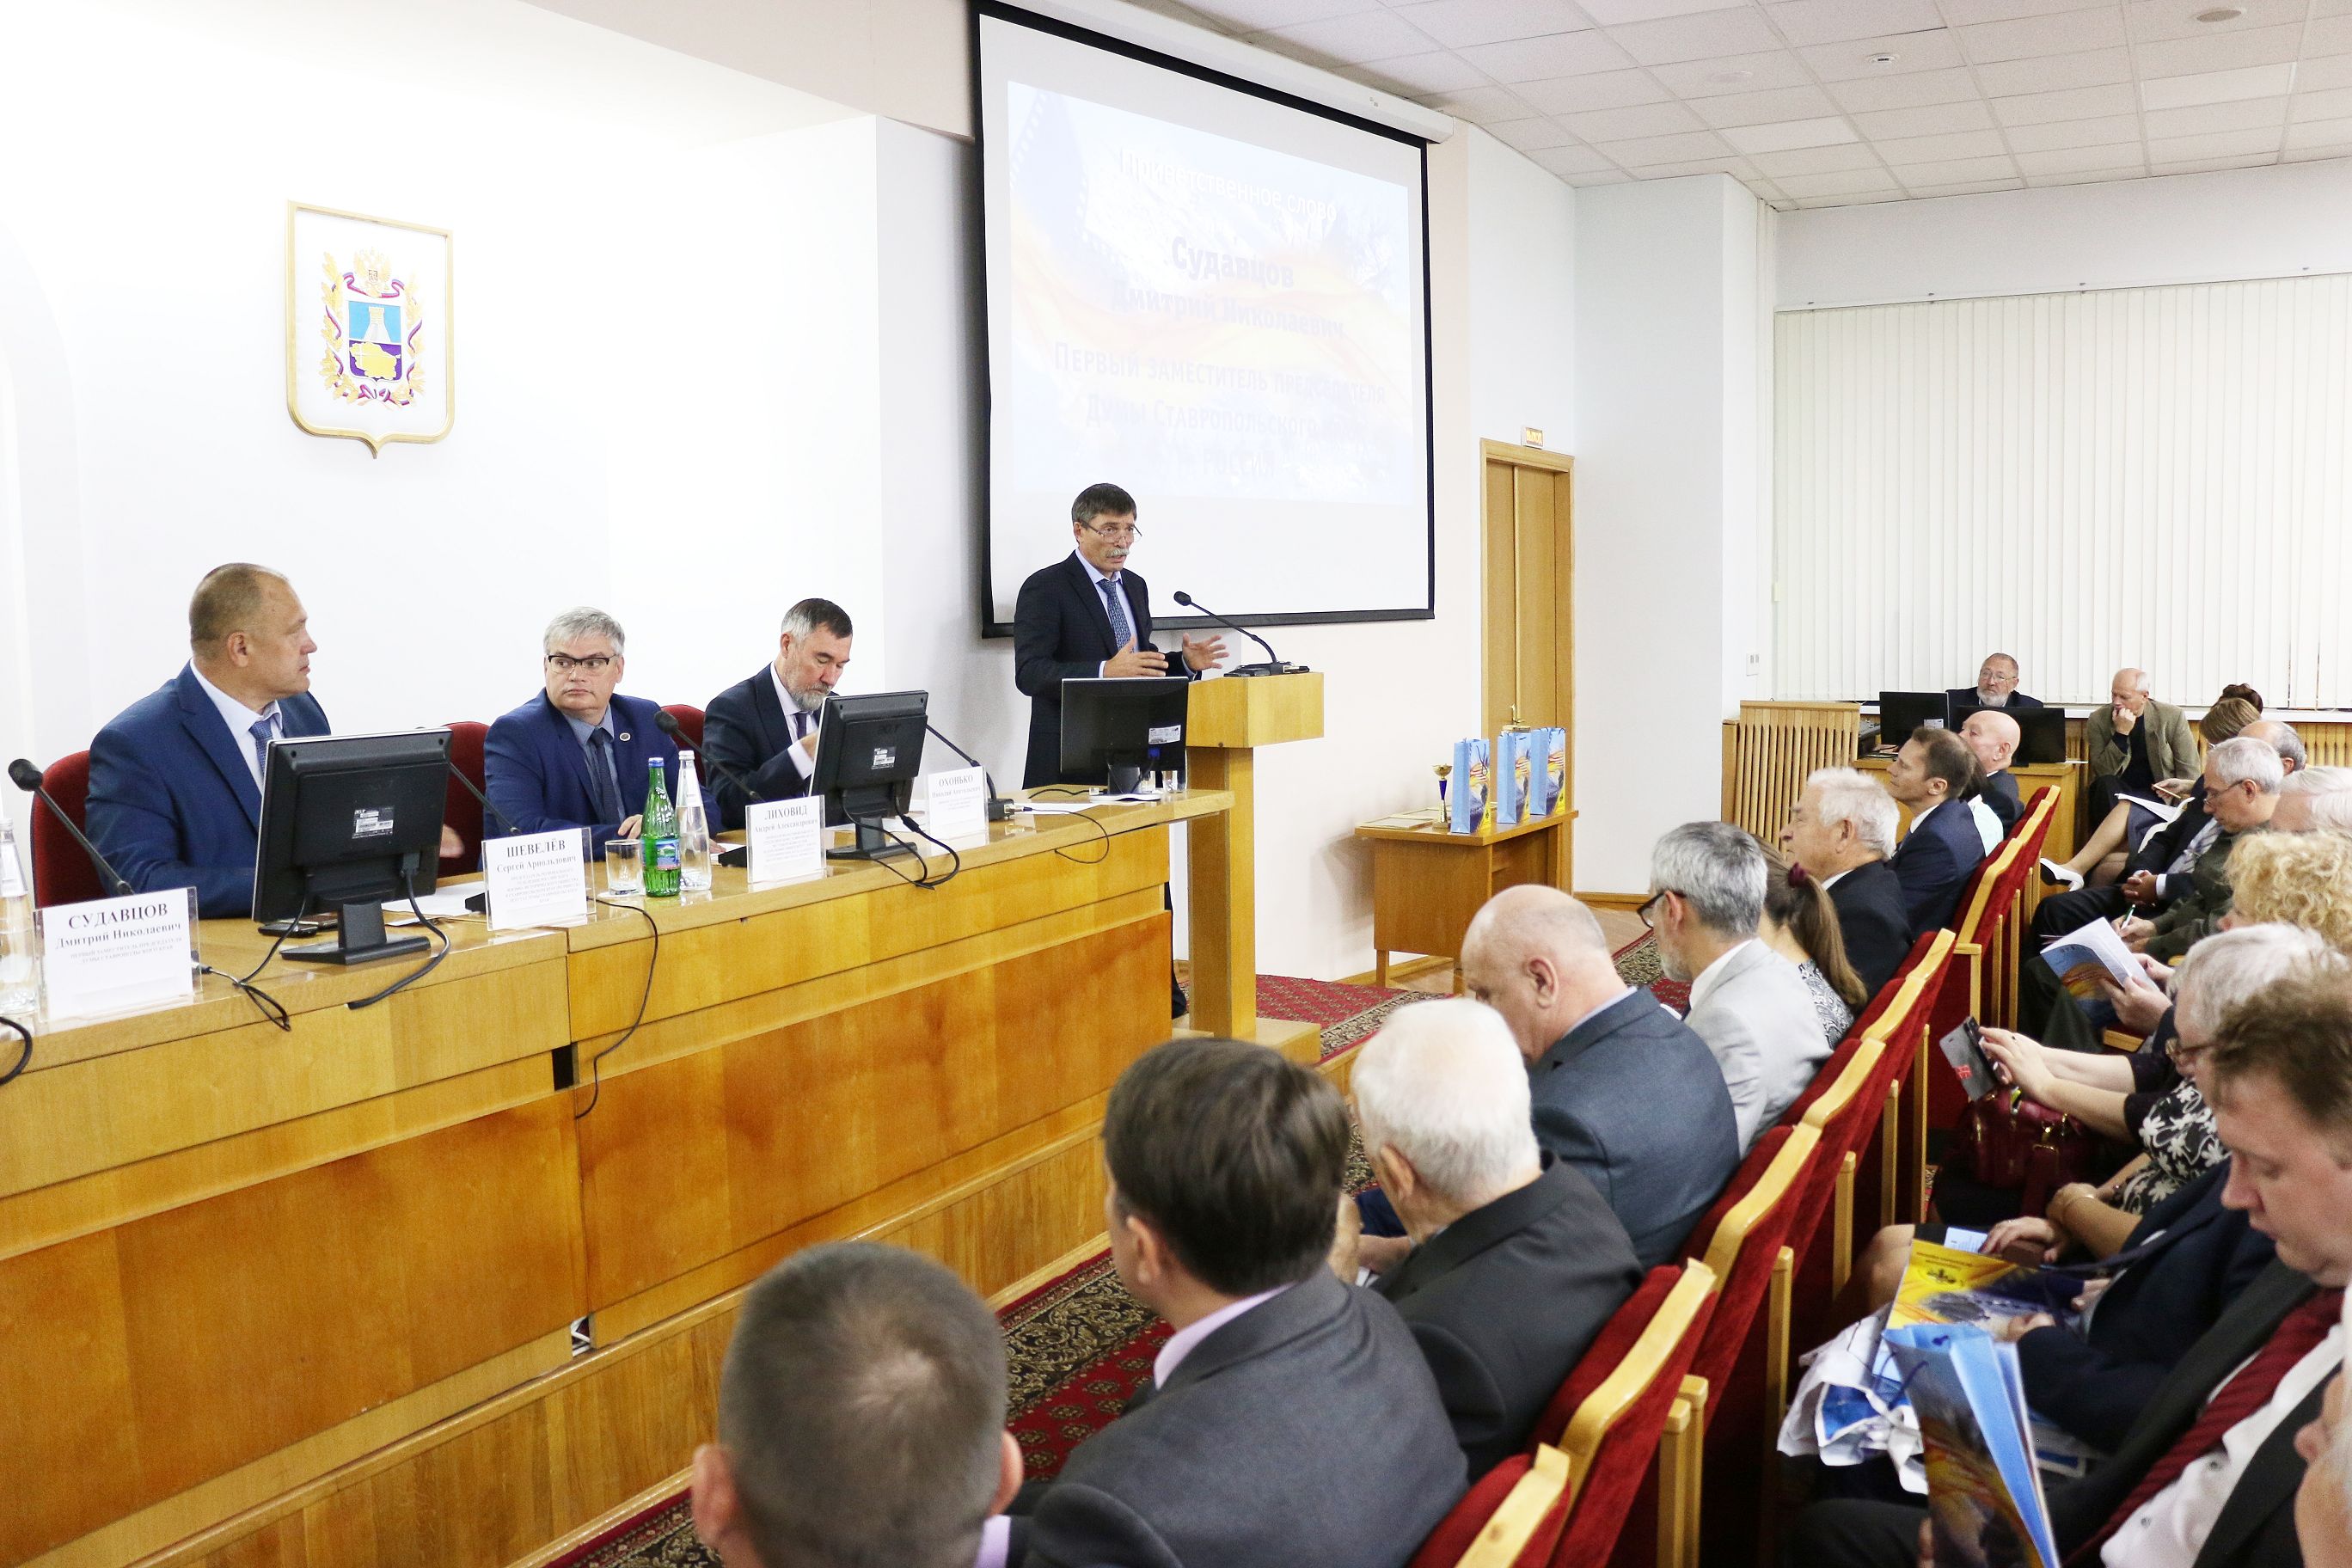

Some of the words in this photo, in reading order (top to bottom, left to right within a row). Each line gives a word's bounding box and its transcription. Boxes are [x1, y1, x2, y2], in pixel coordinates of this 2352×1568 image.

[1172, 236, 1294, 288] Судавцов
[939, 774, 973, 787] ОХОНЬКО
[764, 805, 808, 820] ЛИХОВИД
[506, 837, 566, 858] ШЕВЕЛЁВ
[497, 861, 524, 873] Сергей
[68, 903, 168, 930] СУДАВЦОВ
[56, 931, 109, 950] Дмитрий
[113, 922, 181, 940] Николаевич
